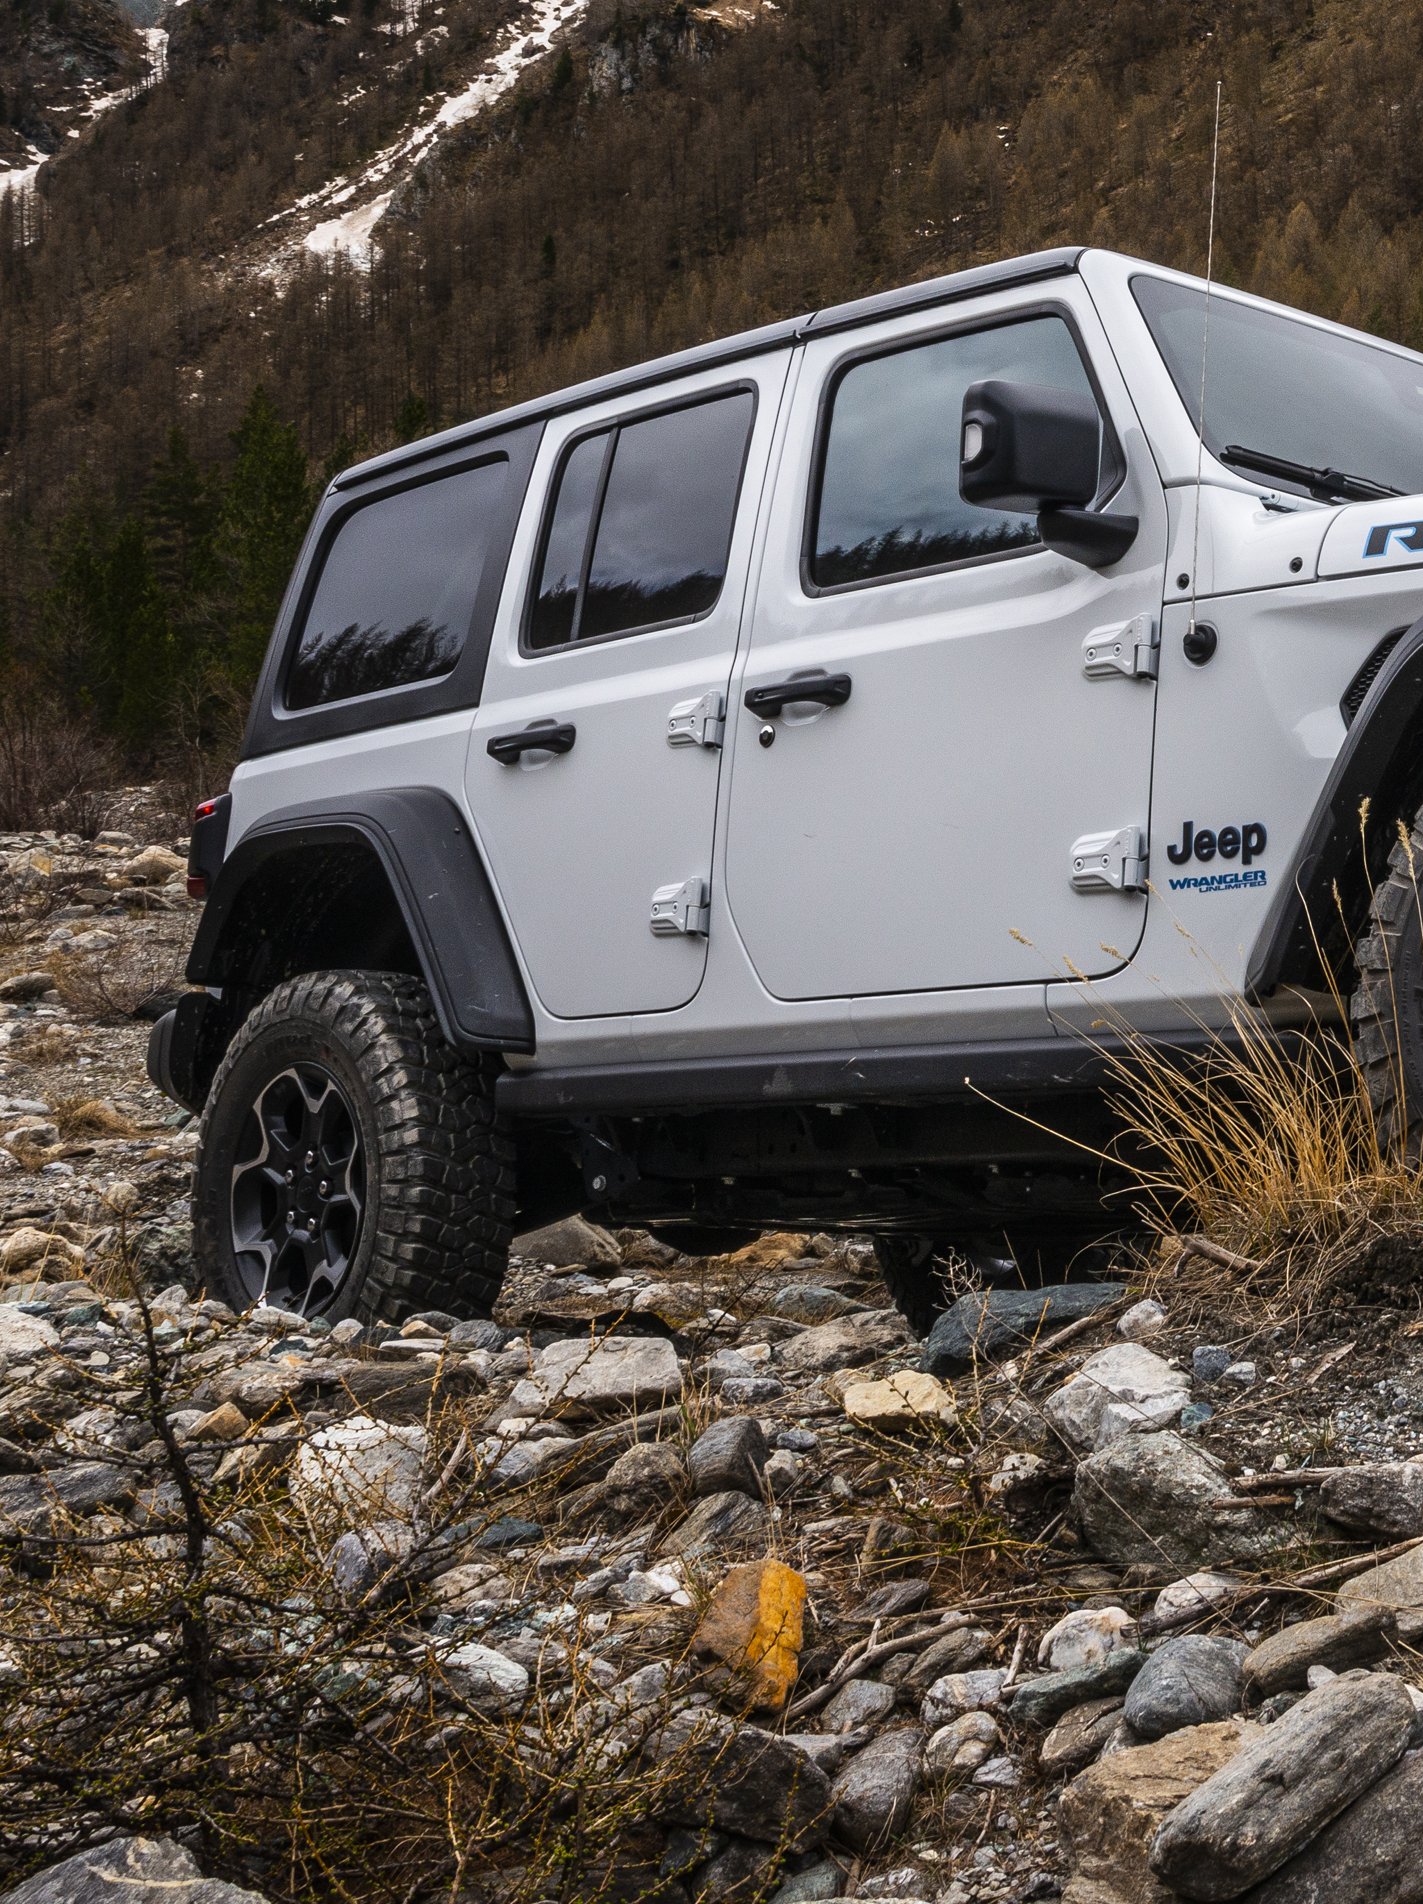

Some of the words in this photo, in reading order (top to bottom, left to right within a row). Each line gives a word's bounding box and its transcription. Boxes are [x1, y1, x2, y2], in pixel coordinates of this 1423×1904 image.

[1167, 821, 1267, 865] Jeep
[1169, 870, 1267, 891] WRANGLER
[1199, 880, 1267, 893] UNLIMITED
